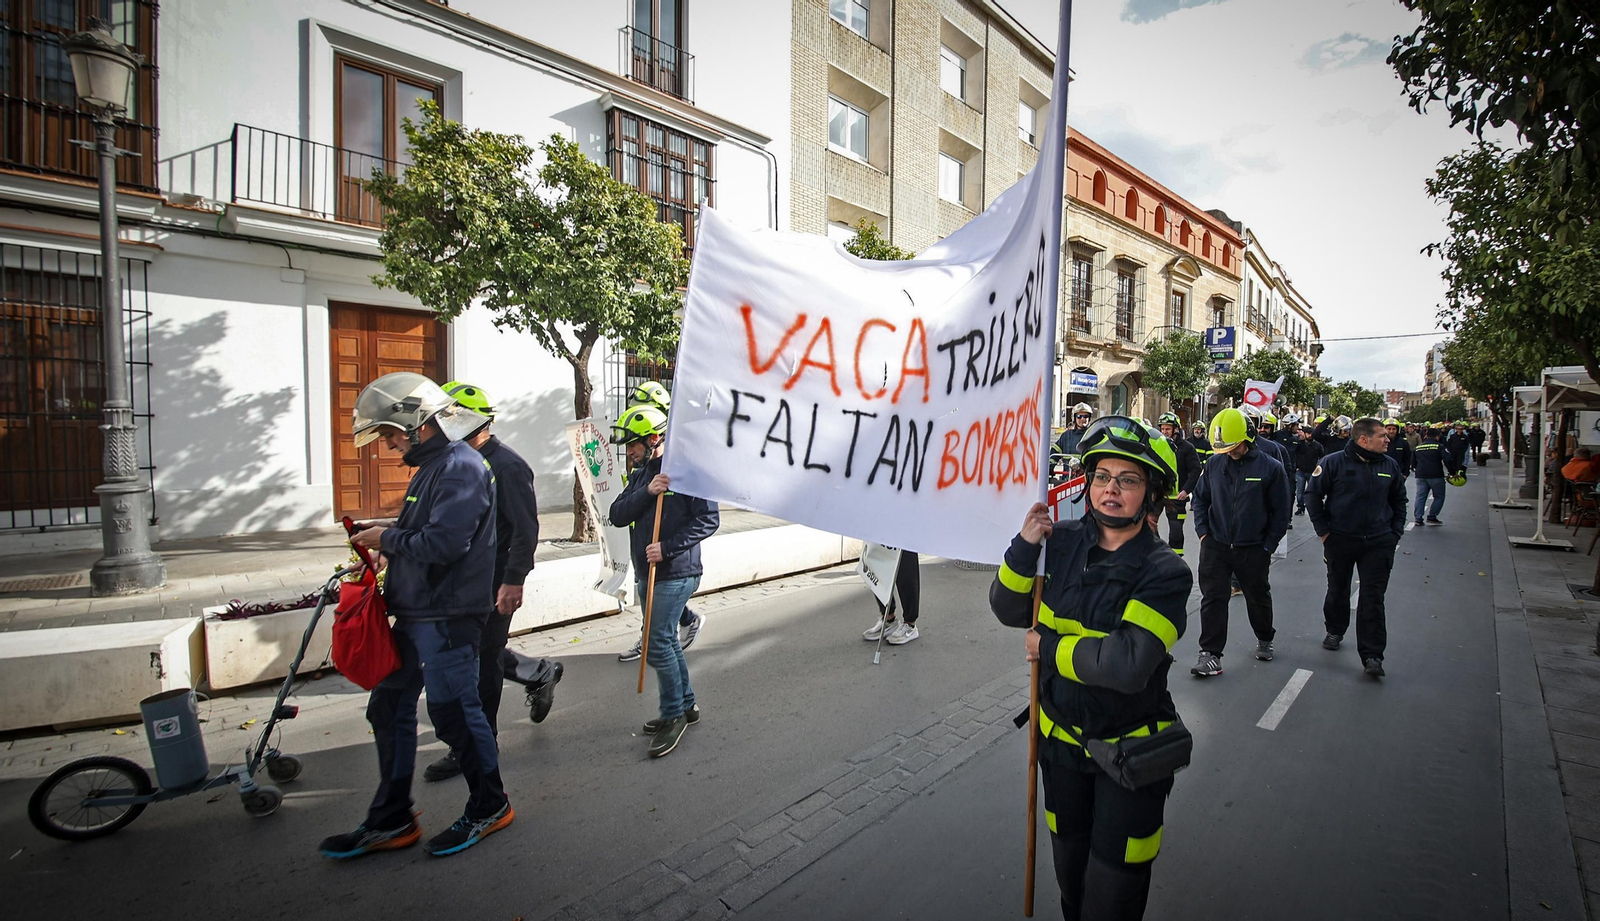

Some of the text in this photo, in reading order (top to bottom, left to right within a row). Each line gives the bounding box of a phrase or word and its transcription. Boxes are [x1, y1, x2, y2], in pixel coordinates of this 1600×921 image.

[739, 304, 930, 404] VACA
[1212, 328, 1227, 345] P
[1071, 373, 1076, 384] P
[590, 423, 613, 476] Bomberos
[727, 374, 1042, 492] FALTAN BOMBEROS
[601, 536, 628, 574] Bberos
